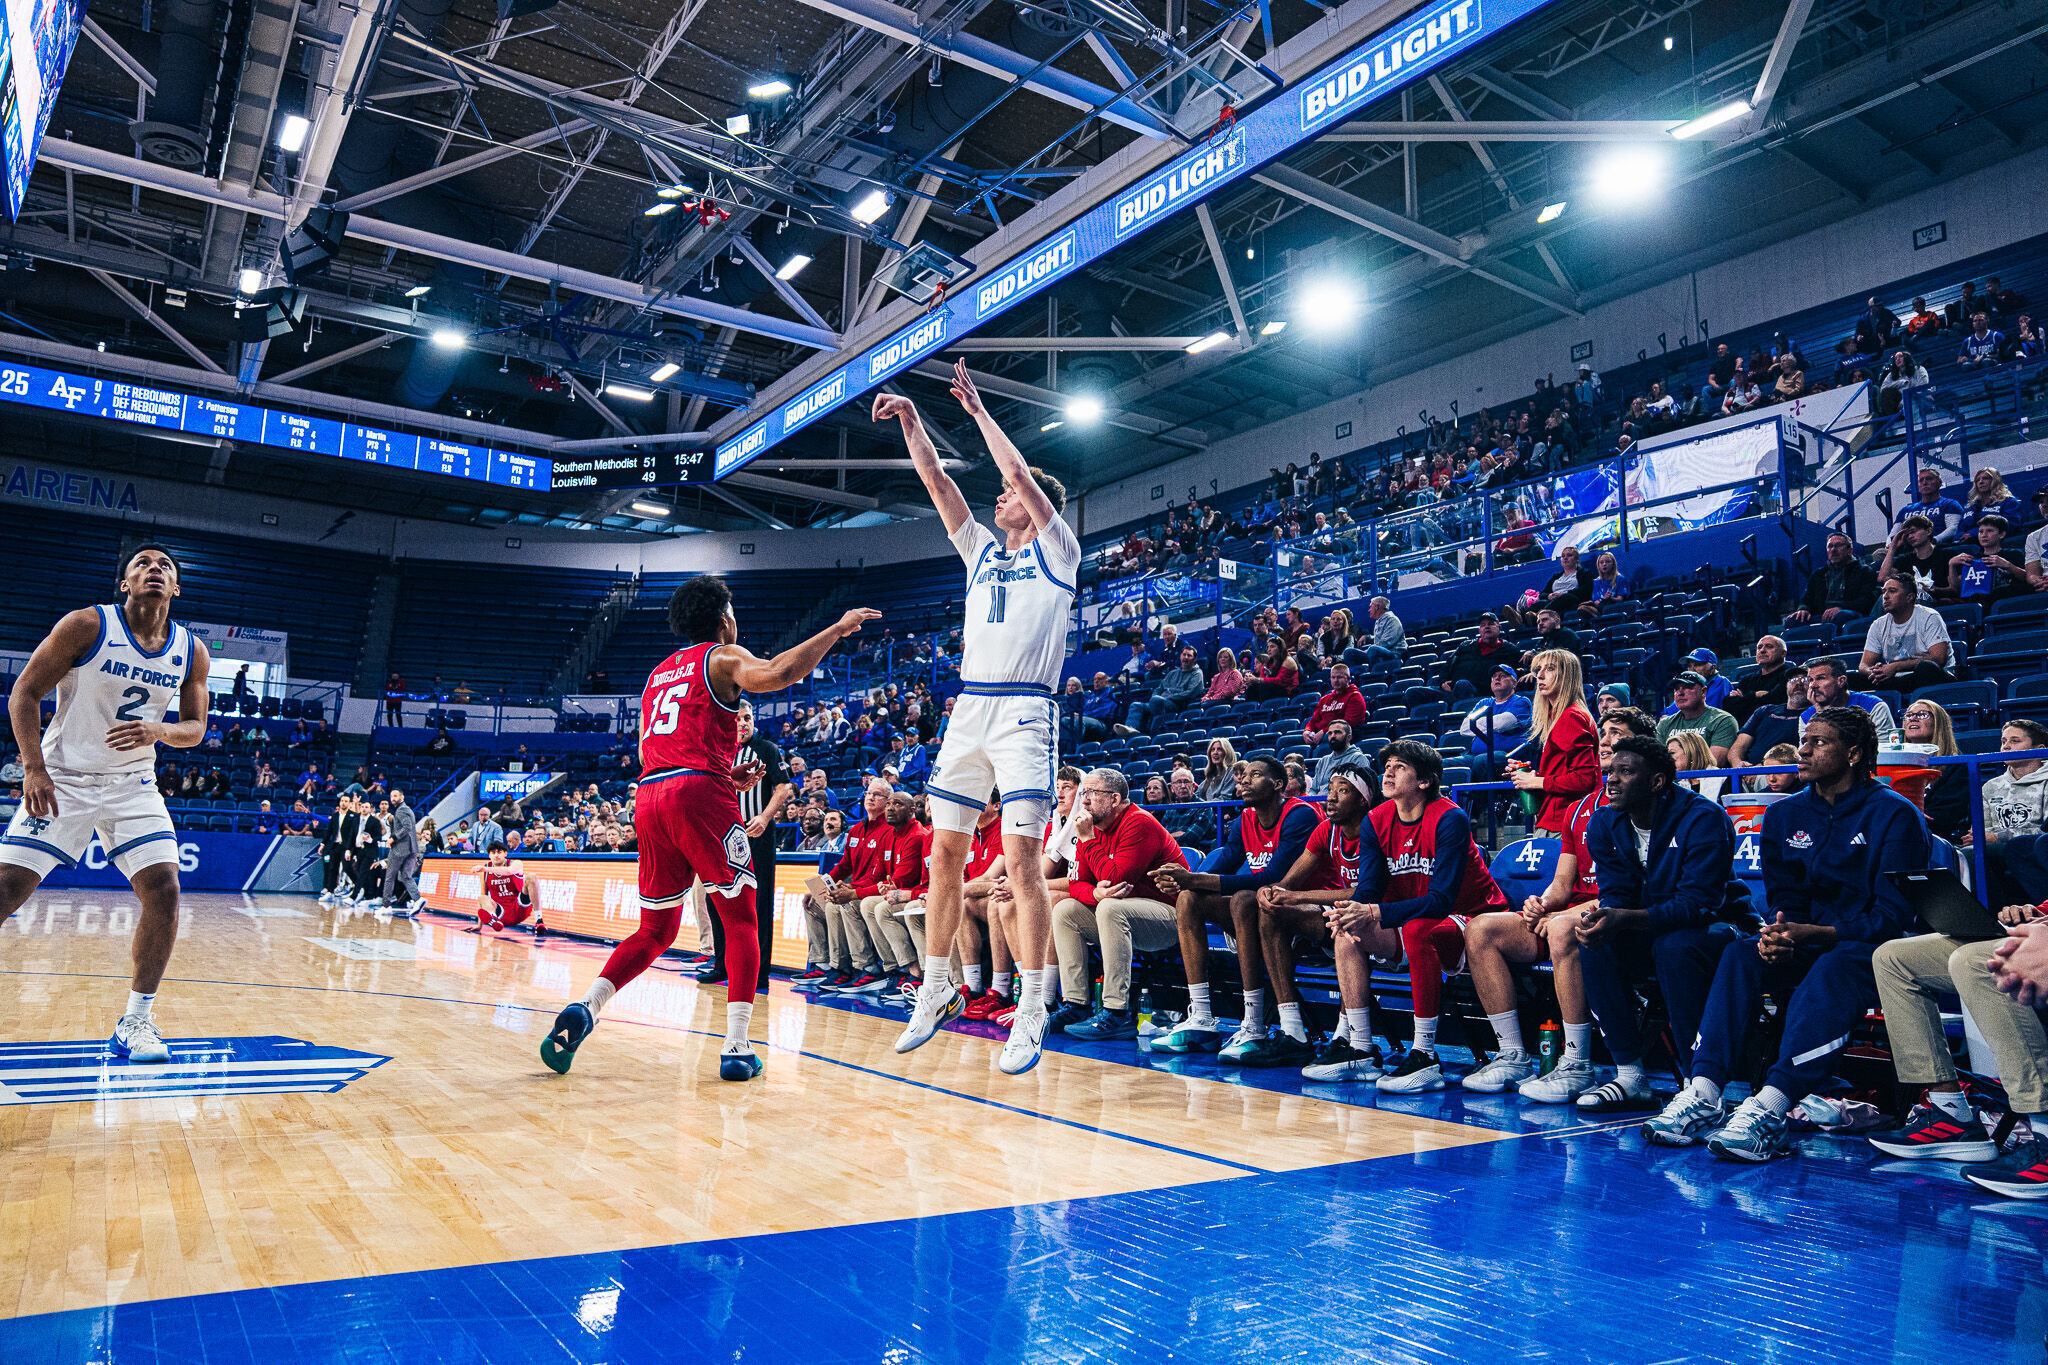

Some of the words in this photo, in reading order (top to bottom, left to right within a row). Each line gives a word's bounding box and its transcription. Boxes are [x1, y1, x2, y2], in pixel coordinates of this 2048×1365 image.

[1306, 62, 1371, 121] BUD
[1374, 2, 1474, 82] LIGHT
[1119, 185, 1167, 230] BUD
[1168, 137, 1241, 201] LIGHT
[980, 275, 1015, 312] BUD
[1017, 238, 1071, 290] LIGHT
[871, 348, 900, 376] BUD
[901, 317, 944, 358] LIGHT
[0, 369, 30, 396] 25
[113, 383, 132, 397] OFF
[131, 386, 181, 406] REBOUNDS
[786, 404, 808, 428] BUD
[808, 378, 844, 417] LIGHT
[93, 393, 101, 404] 7
[112, 396, 130, 409] DEF
[131, 399, 180, 418] REBOUNDS
[197, 400, 204, 409] 2
[206, 402, 239, 415] Patterson
[101, 407, 107, 416] 4
[114, 409, 134, 421] TEAM
[134, 412, 157, 425] FOULS
[215, 414, 228, 424] PTS
[229, 416, 236, 425] 0
[213, 425, 226, 435] FLS
[228, 427, 235, 437] 0
[291, 427, 305, 437] PTS
[310, 430, 316, 439] 4
[1783, 421, 1798, 439] L15
[290, 438, 302, 448] FLS
[309, 441, 316, 450] 0
[367, 440, 379, 450] PTS
[718, 442, 737, 470] BUD
[737, 428, 765, 459] LIGHT
[365, 451, 377, 461] FLS
[385, 454, 389, 462] 1
[442, 453, 454, 463] PTS
[552, 461, 592, 473] Southern
[594, 457, 638, 471] Methodist
[643, 457, 656, 468] 51
[674, 453, 704, 465] 15:47
[441, 464, 452, 473] FLS
[511, 465, 523, 475] PTS
[510, 476, 521, 485] FLS
[552, 475, 597, 488] Louisville
[641, 471, 656, 482] 49
[680, 470, 688, 481] 2
[5, 465, 140, 513] ARENA
[988, 566, 1037, 583] FORCE
[1221, 564, 1235, 575] L14
[1965, 566, 1988, 586] AF
[987, 585, 1007, 623] 11
[240, 634, 282, 643] COMMAND
[100, 659, 129, 677] AIR
[131, 668, 181, 689] FORCE
[115, 685, 151, 721] 2
[642, 682, 690, 741] 15
[485, 779, 545, 794] AFTICKETSCOM
[1515, 840, 1544, 872] AF
